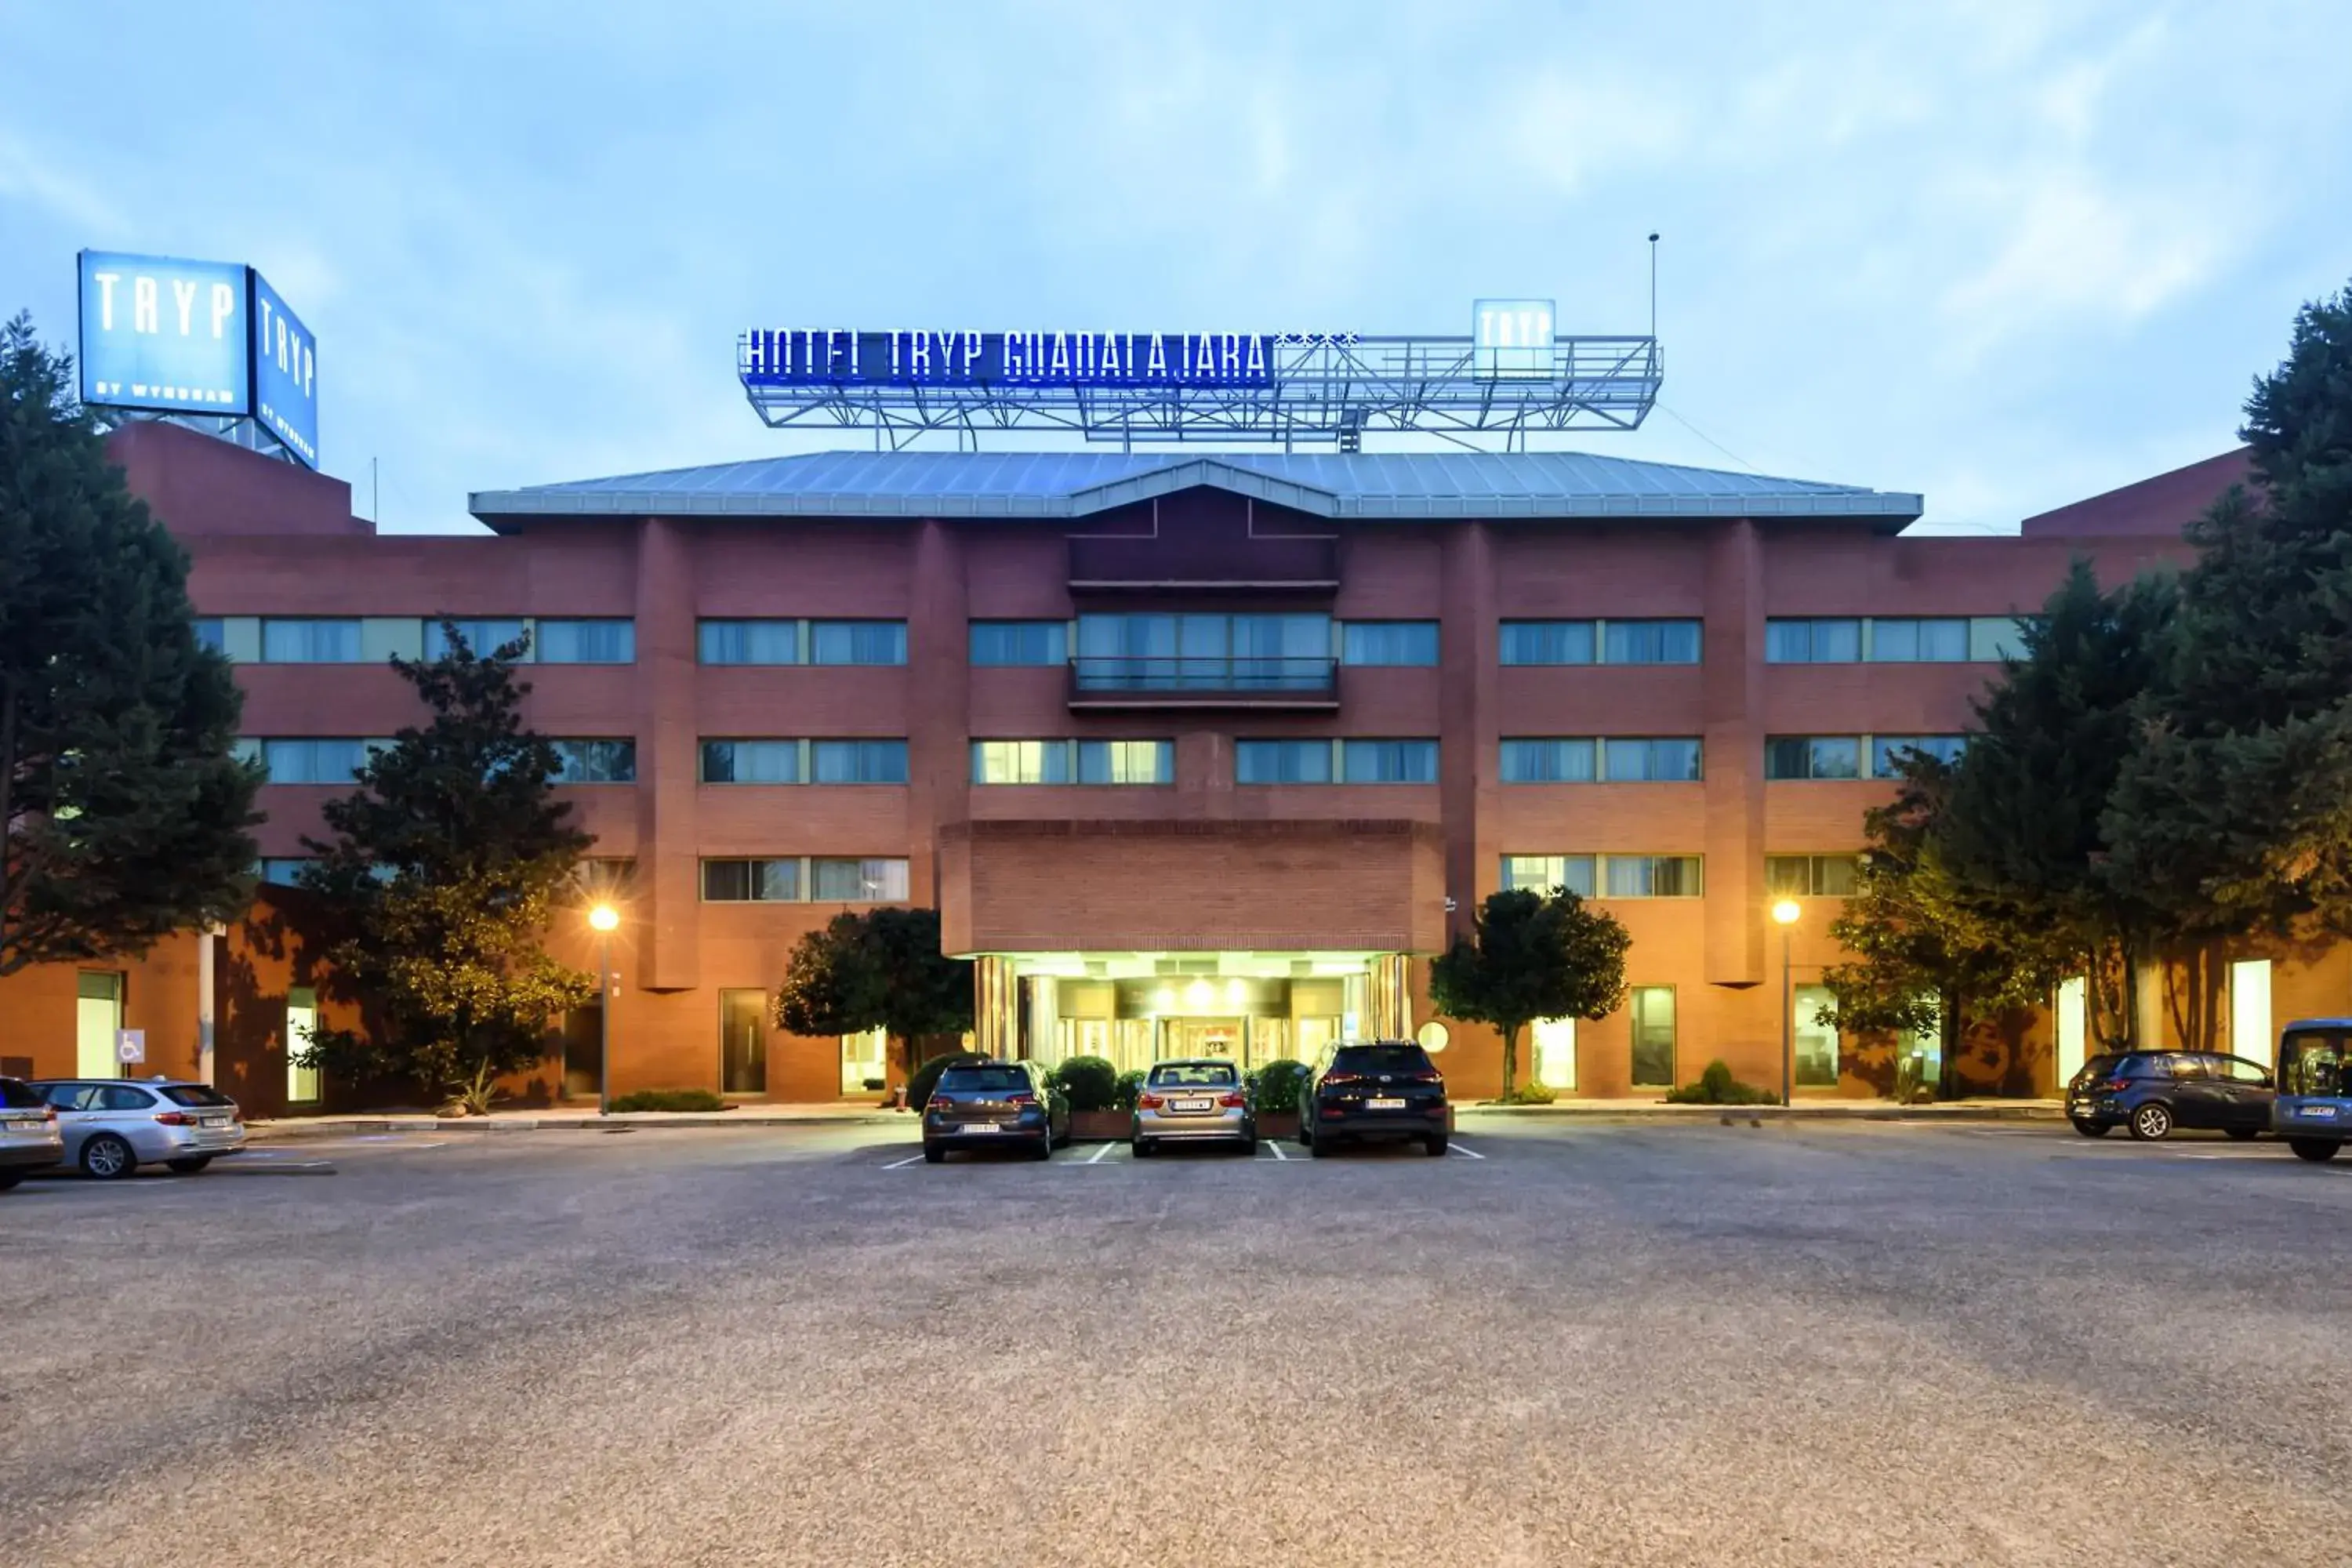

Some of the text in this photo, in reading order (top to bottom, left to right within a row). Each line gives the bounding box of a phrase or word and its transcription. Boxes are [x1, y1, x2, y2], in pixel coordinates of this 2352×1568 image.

[95, 273, 234, 339] TRYP
[260, 297, 313, 399] TRYP
[886, 328, 982, 381] TRYP
